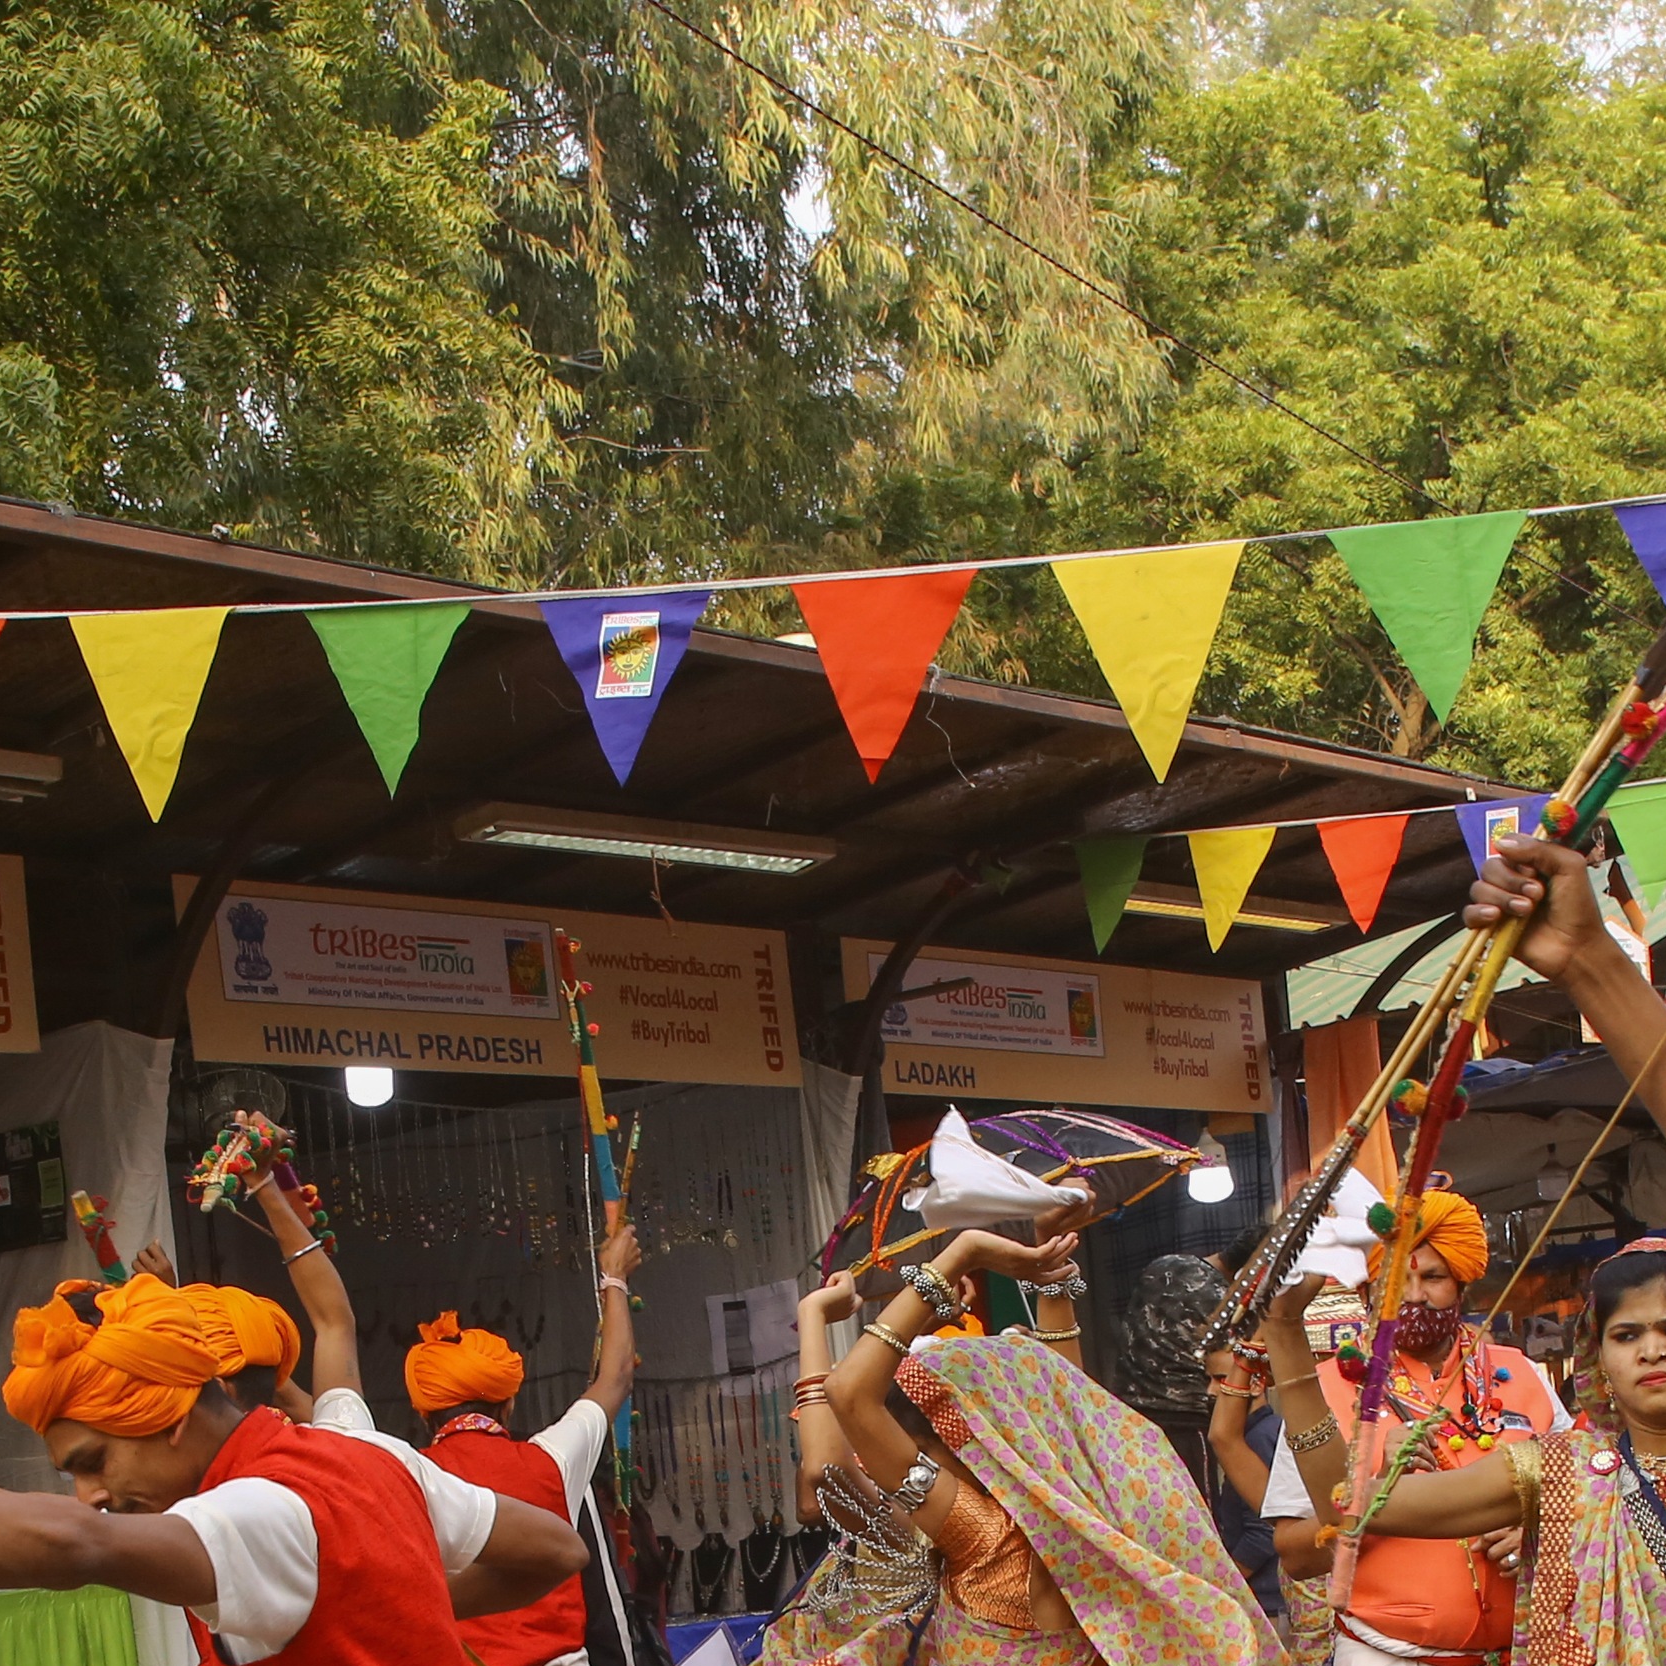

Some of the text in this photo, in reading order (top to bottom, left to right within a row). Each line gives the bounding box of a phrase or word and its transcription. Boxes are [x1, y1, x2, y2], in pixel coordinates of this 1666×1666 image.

[620, 985, 719, 1013] #Vocal4Local
[754, 943, 785, 1073] TRIFED
[263, 1025, 543, 1065] HIMACHAL PRADESH
[631, 1019, 711, 1048] #BuyTribal
[1238, 993, 1262, 1101] TRIFED
[895, 1060, 975, 1089] LADAKH
[1154, 1056, 1209, 1080] #BuyTribal
